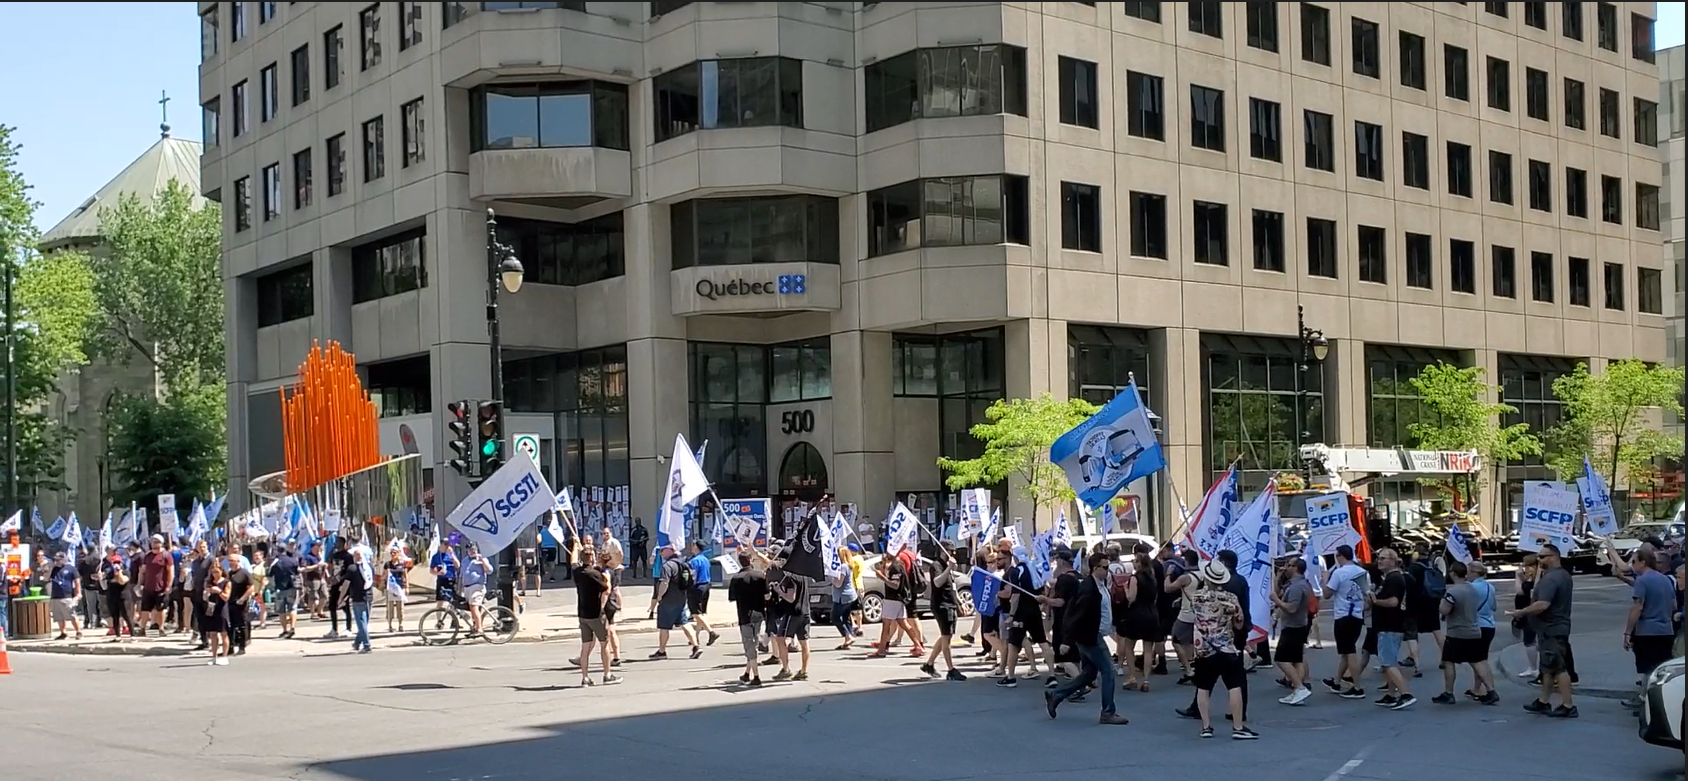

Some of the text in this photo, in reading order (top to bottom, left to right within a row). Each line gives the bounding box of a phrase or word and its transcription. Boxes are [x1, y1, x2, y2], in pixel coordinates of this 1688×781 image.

[696, 279, 775, 300] Québec
[781, 410, 815, 434] 500
[495, 472, 539, 517] SCSTL
[723, 503, 740, 513] 500
[1525, 507, 1573, 525] SCFP
[1310, 512, 1349, 528] SCFP
